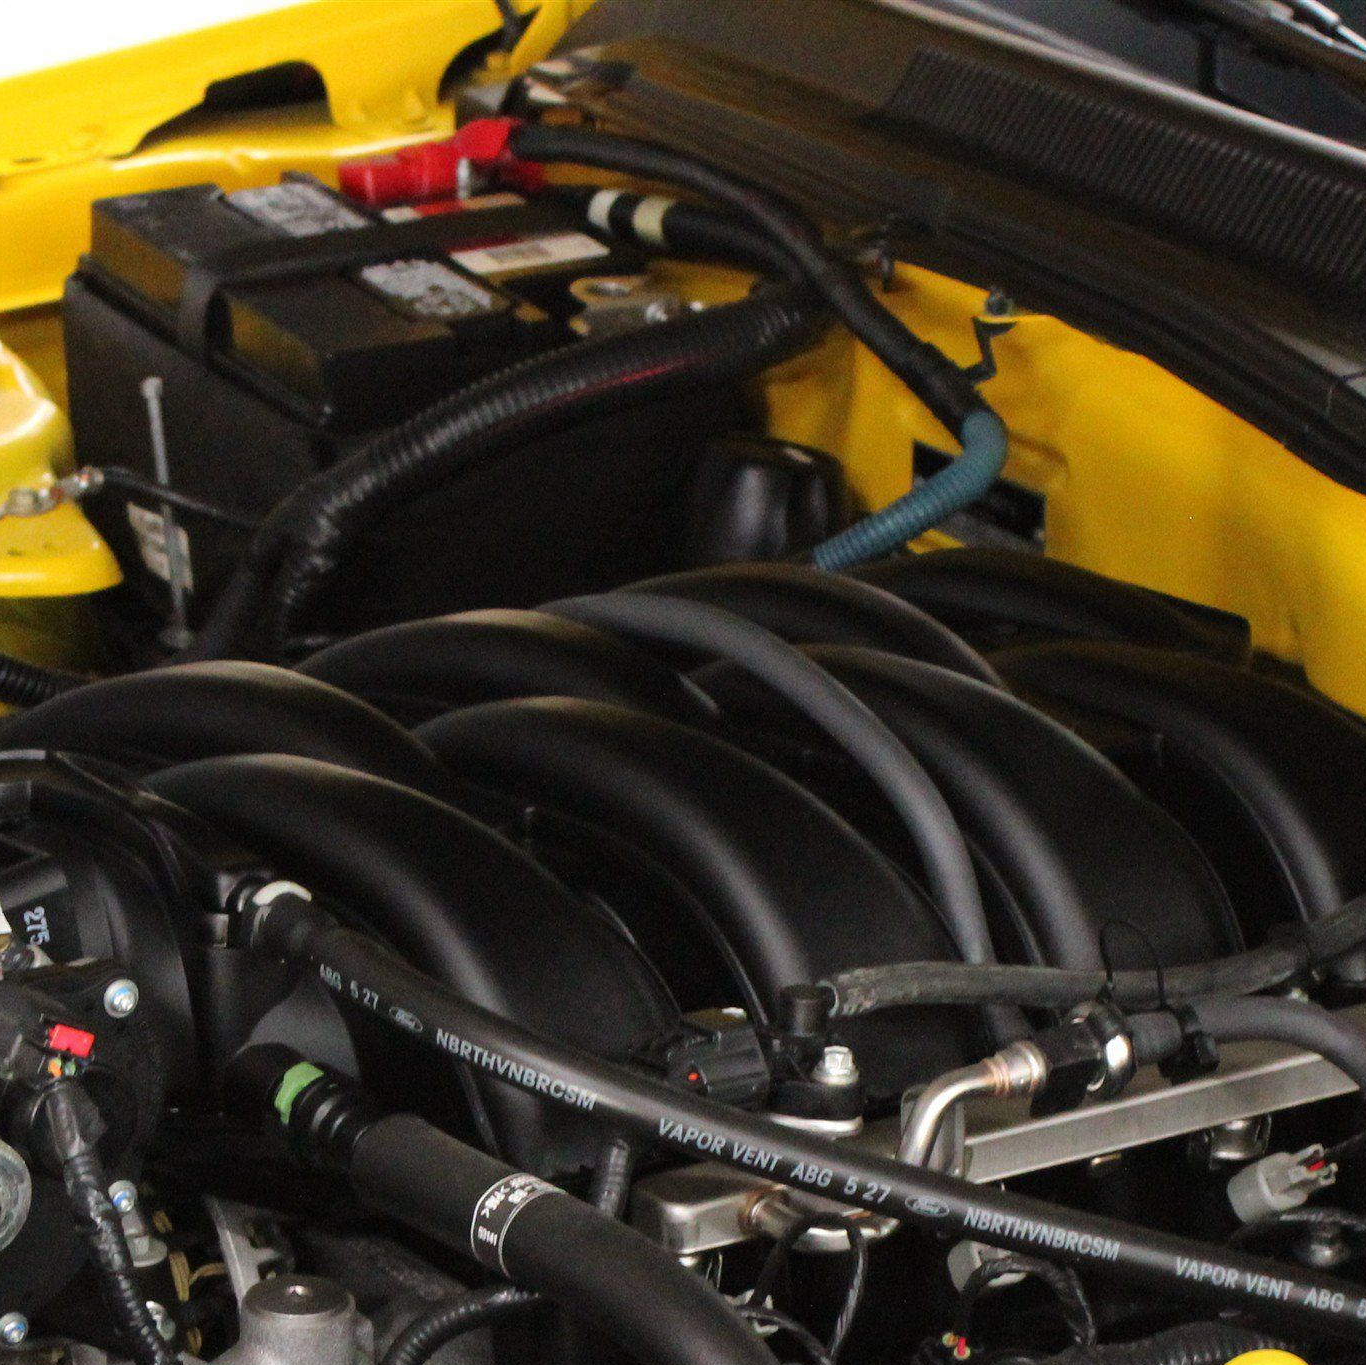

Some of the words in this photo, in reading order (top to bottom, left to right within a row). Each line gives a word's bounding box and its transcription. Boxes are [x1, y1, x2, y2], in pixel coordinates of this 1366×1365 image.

[362, 987, 380, 1011] 27
[435, 1027, 598, 1112] NBRTHVNBRCSM
[658, 1117, 726, 1156] VAPOR
[731, 1140, 784, 1173] VENT
[790, 1159, 834, 1189] ABG
[843, 1175, 857, 1197] 5
[861, 1181, 892, 1205] 27
[962, 1207, 1122, 1261] NBRTHVNBRCSM
[1174, 1256, 1239, 1287] VAPOR
[1244, 1272, 1295, 1301] VENT
[1302, 1286, 1346, 1313] ABG
